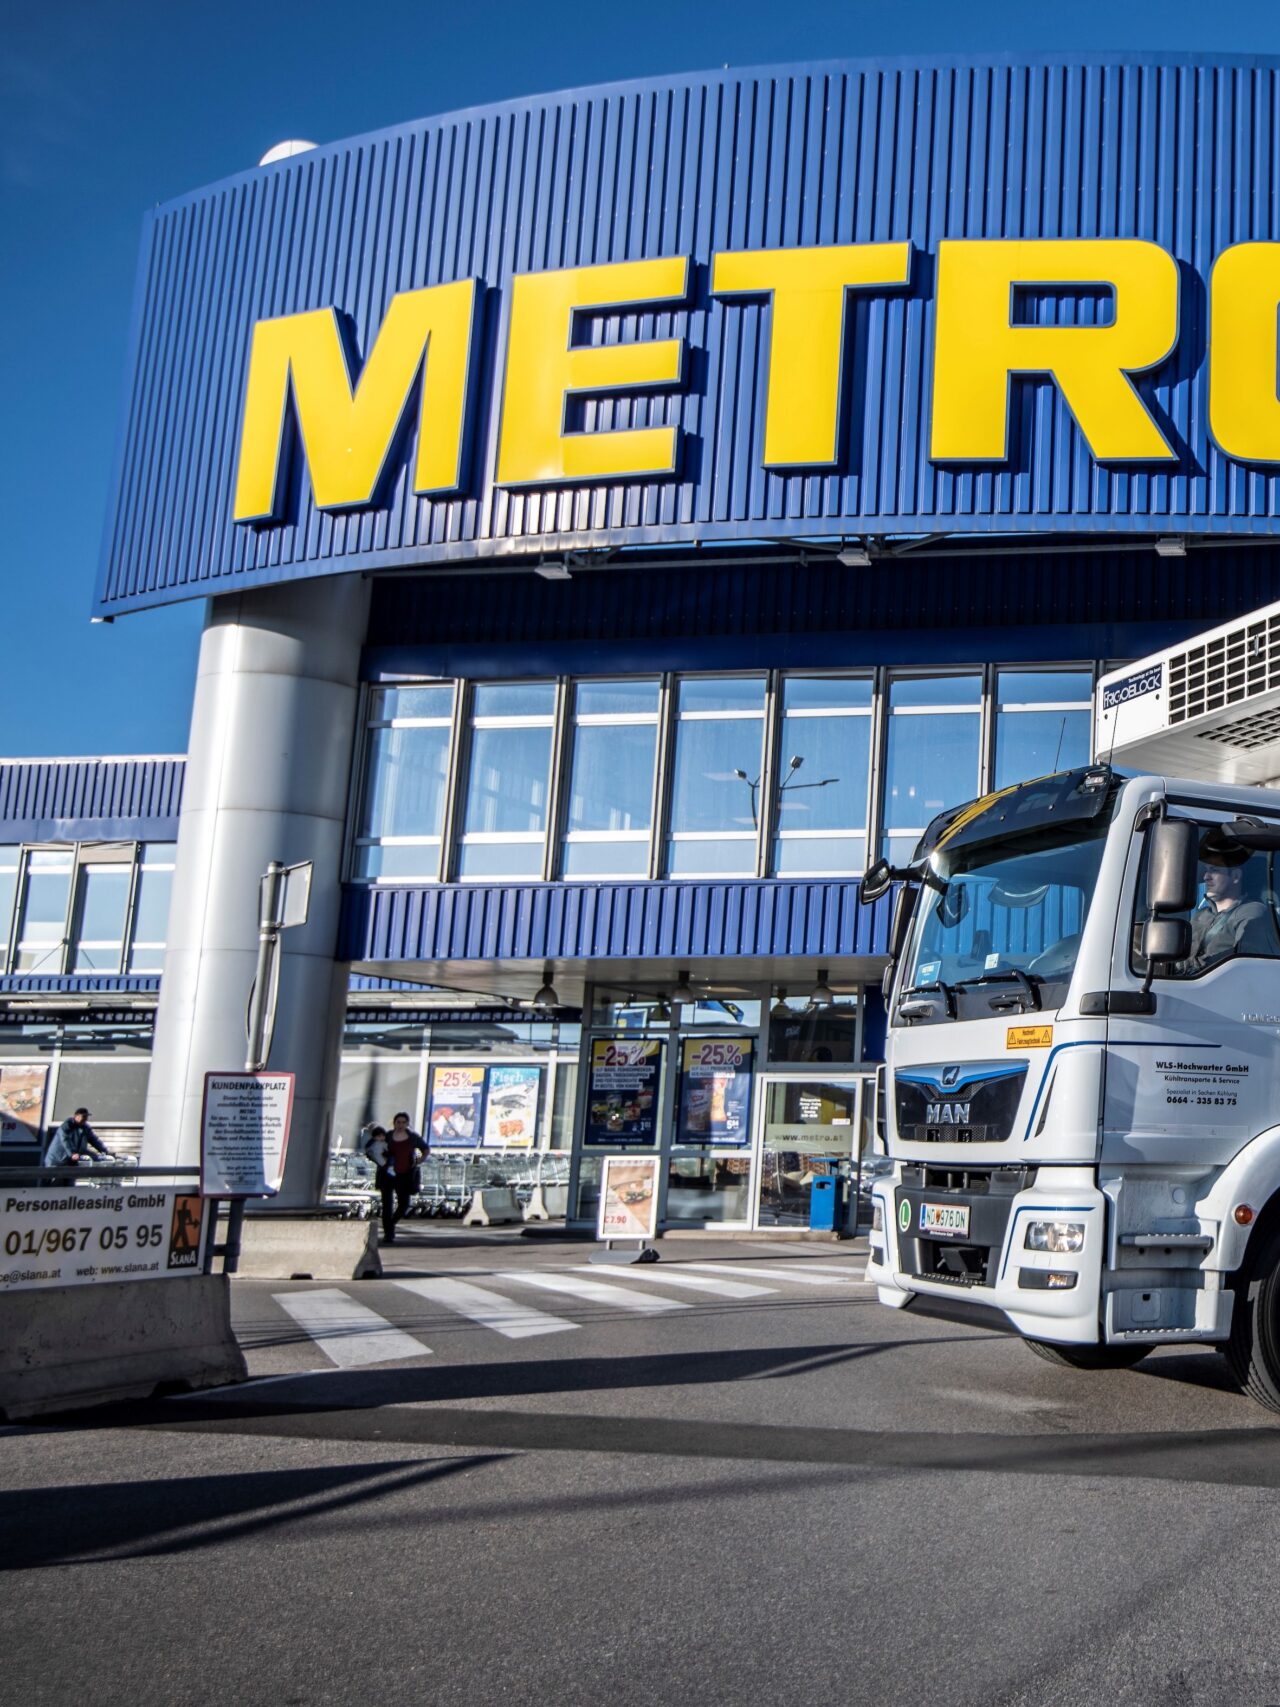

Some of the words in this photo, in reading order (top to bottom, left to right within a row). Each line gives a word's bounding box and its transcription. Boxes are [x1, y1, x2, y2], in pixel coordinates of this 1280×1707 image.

[691, 1044, 743, 1066] -25%
[1155, 1061, 1224, 1072] WLS-Hochwarter
[1225, 1064, 1249, 1073] GmbH
[211, 1082, 287, 1091] KUNDENPARKPLATZ
[436, 1071, 473, 1088] -25%
[1164, 1075, 1211, 1084] Kühltransporte
[1218, 1077, 1240, 1085] Service
[1166, 1088, 1191, 1096] Spezialist
[1217, 1090, 1238, 1098] Kühlung
[1166, 1096, 1188, 1104] 0664
[1196, 1097, 1212, 1105] 335
[1226, 1098, 1237, 1106] 75
[925, 1103, 971, 1125] MAN
[775, 1134, 844, 1142] www.metro.at
[6, 1195, 124, 1213] Personalleasing
[127, 1194, 166, 1208] GmbH
[902, 1206, 908, 1226] L
[5, 1227, 92, 1257] 01/967
[99, 1226, 128, 1250] 05
[136, 1224, 163, 1248] 95
[76, 1266, 99, 1277] web:
[101, 1261, 160, 1275] www.slana.at
